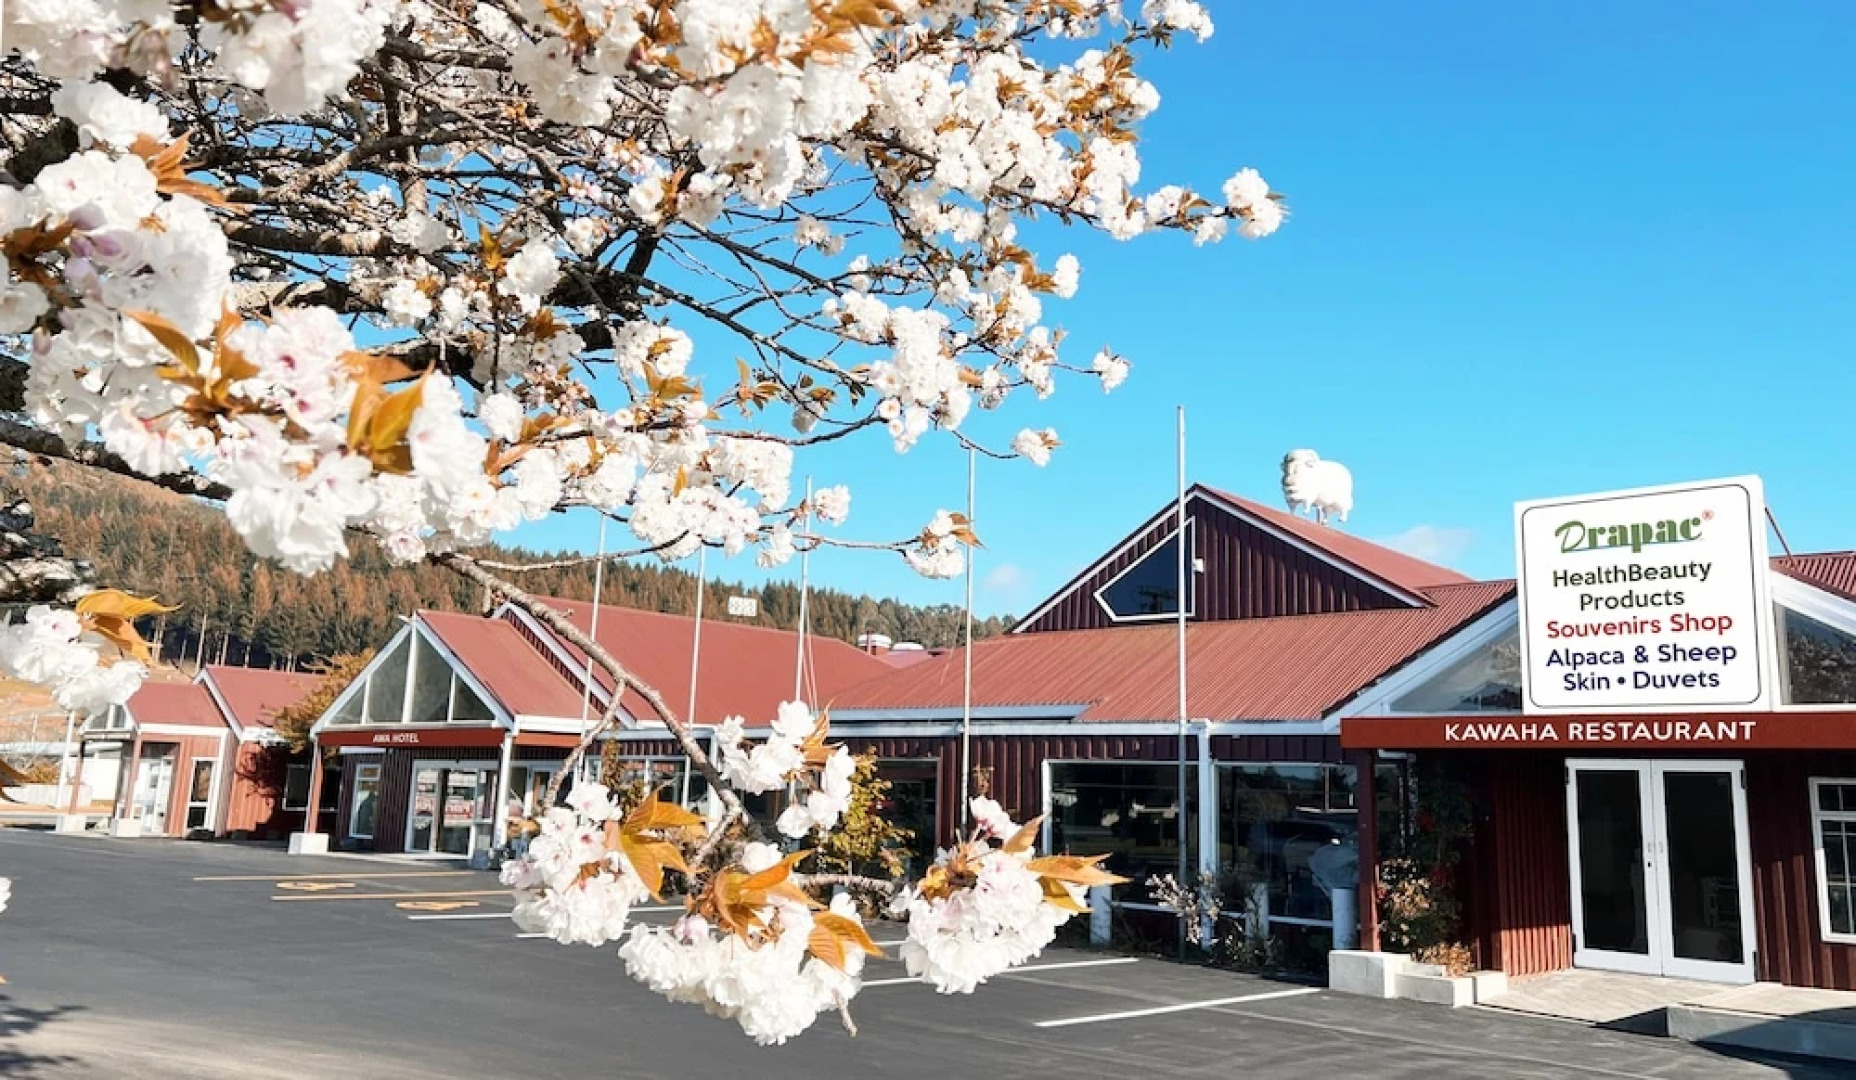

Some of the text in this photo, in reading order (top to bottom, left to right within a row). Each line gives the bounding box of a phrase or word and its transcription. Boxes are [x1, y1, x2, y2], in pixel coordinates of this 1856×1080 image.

[1552, 561, 1712, 588] HealthBeauty
[1580, 589, 1685, 612] Products
[1547, 613, 1733, 639] Souvenirs Shop
[1545, 643, 1737, 671] Alpaca & Sheep
[1563, 671, 1610, 691] Skin
[1632, 671, 1720, 690] Duvets
[392, 732, 420, 743] HOTEL
[1444, 721, 1757, 742] KAWAHA RESTAURANT
